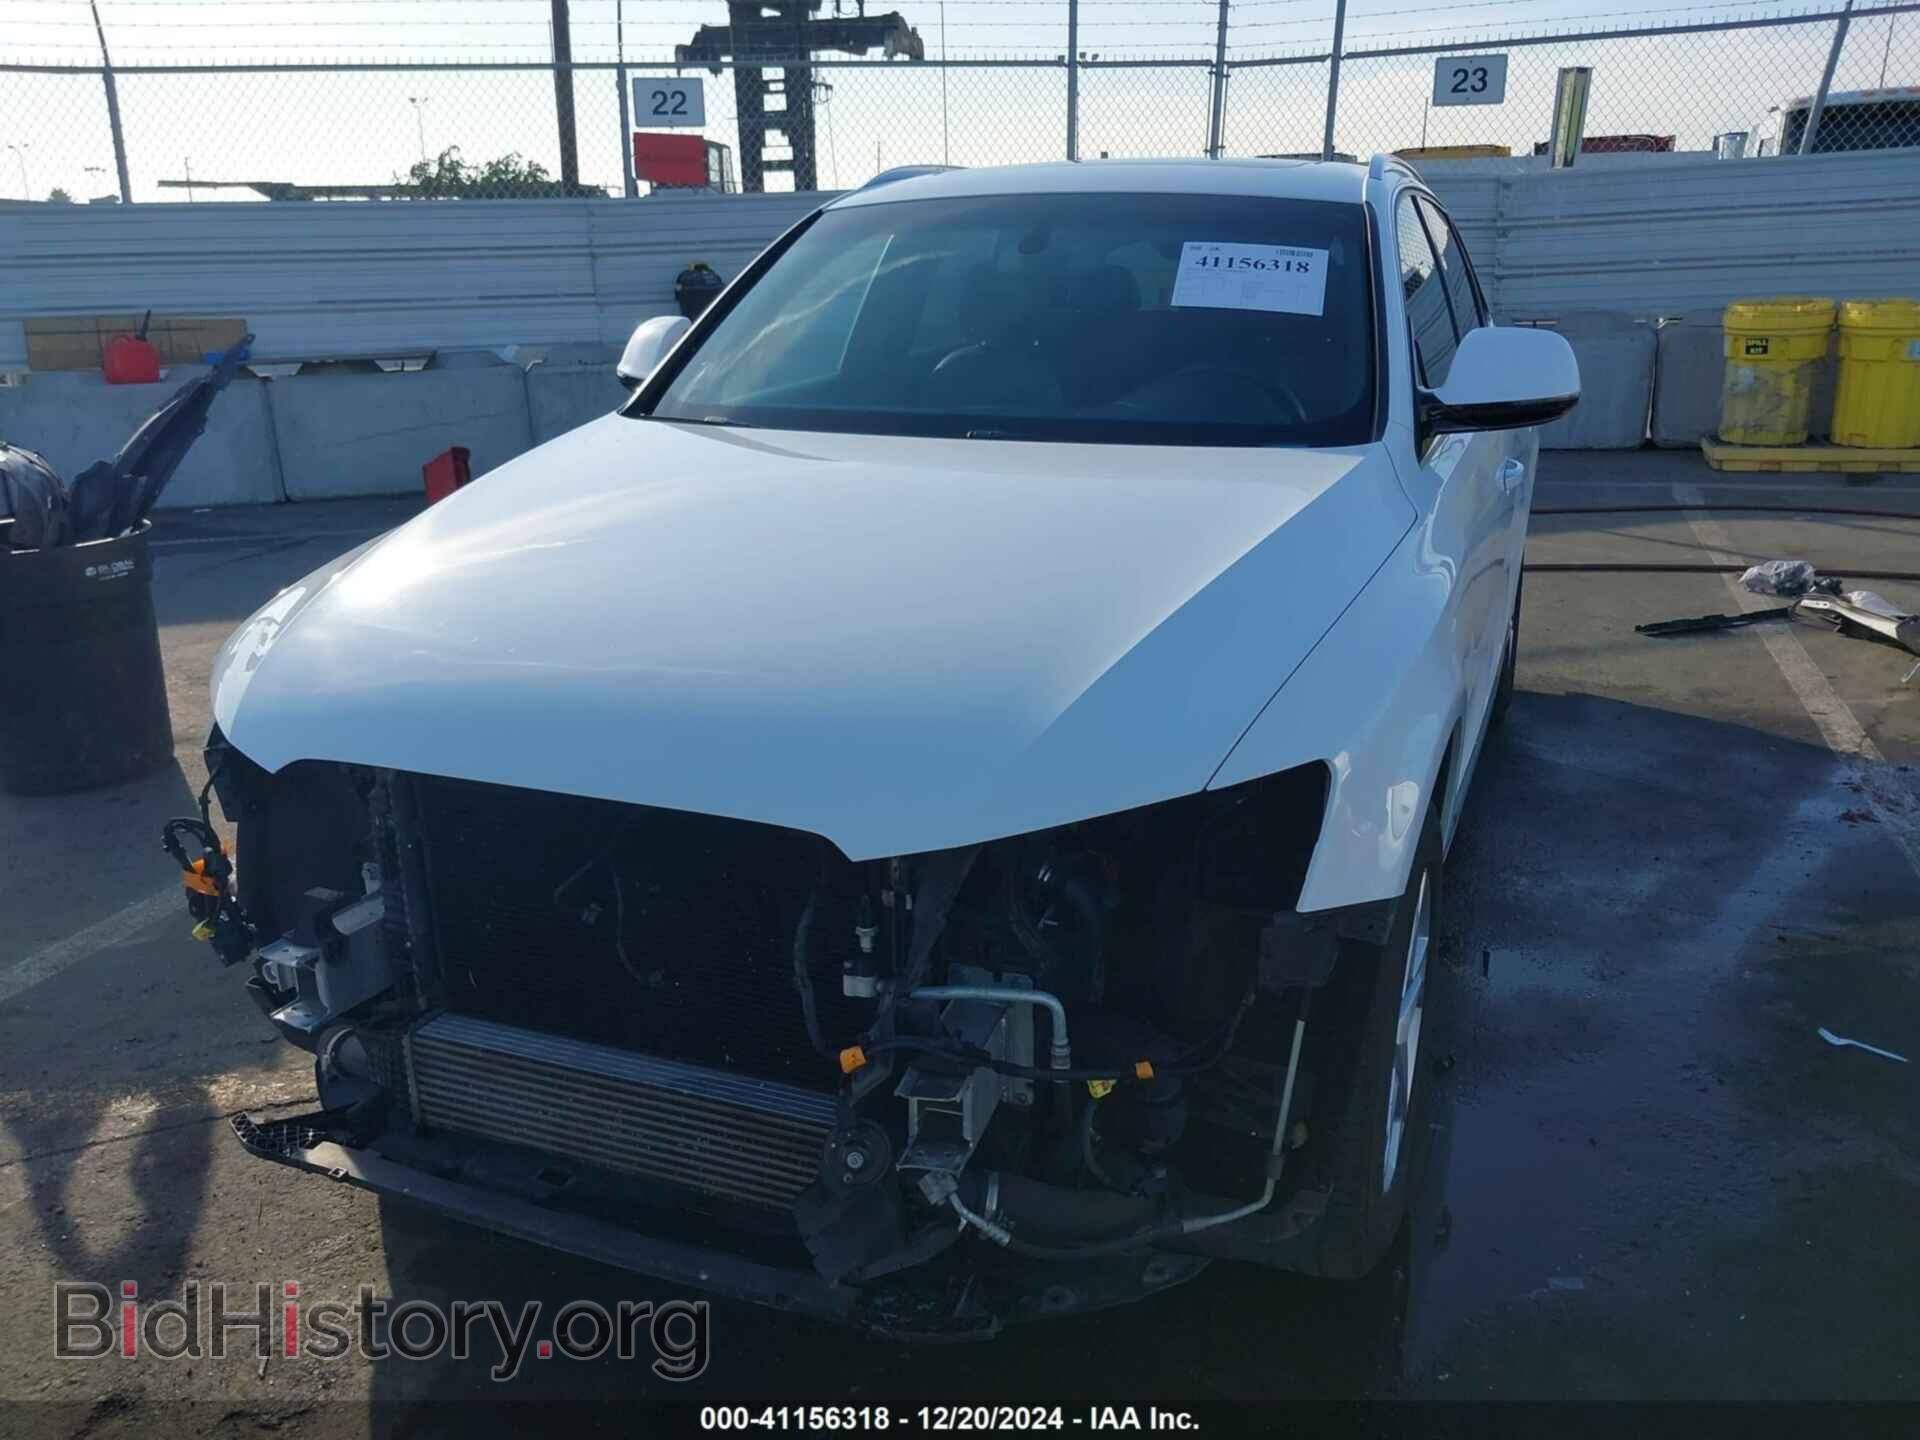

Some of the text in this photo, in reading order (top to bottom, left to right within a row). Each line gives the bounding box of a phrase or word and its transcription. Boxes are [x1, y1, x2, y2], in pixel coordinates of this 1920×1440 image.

[1452, 67, 1488, 93] 23
[651, 90, 688, 116] 22
[1195, 255, 1310, 273] 41156318
